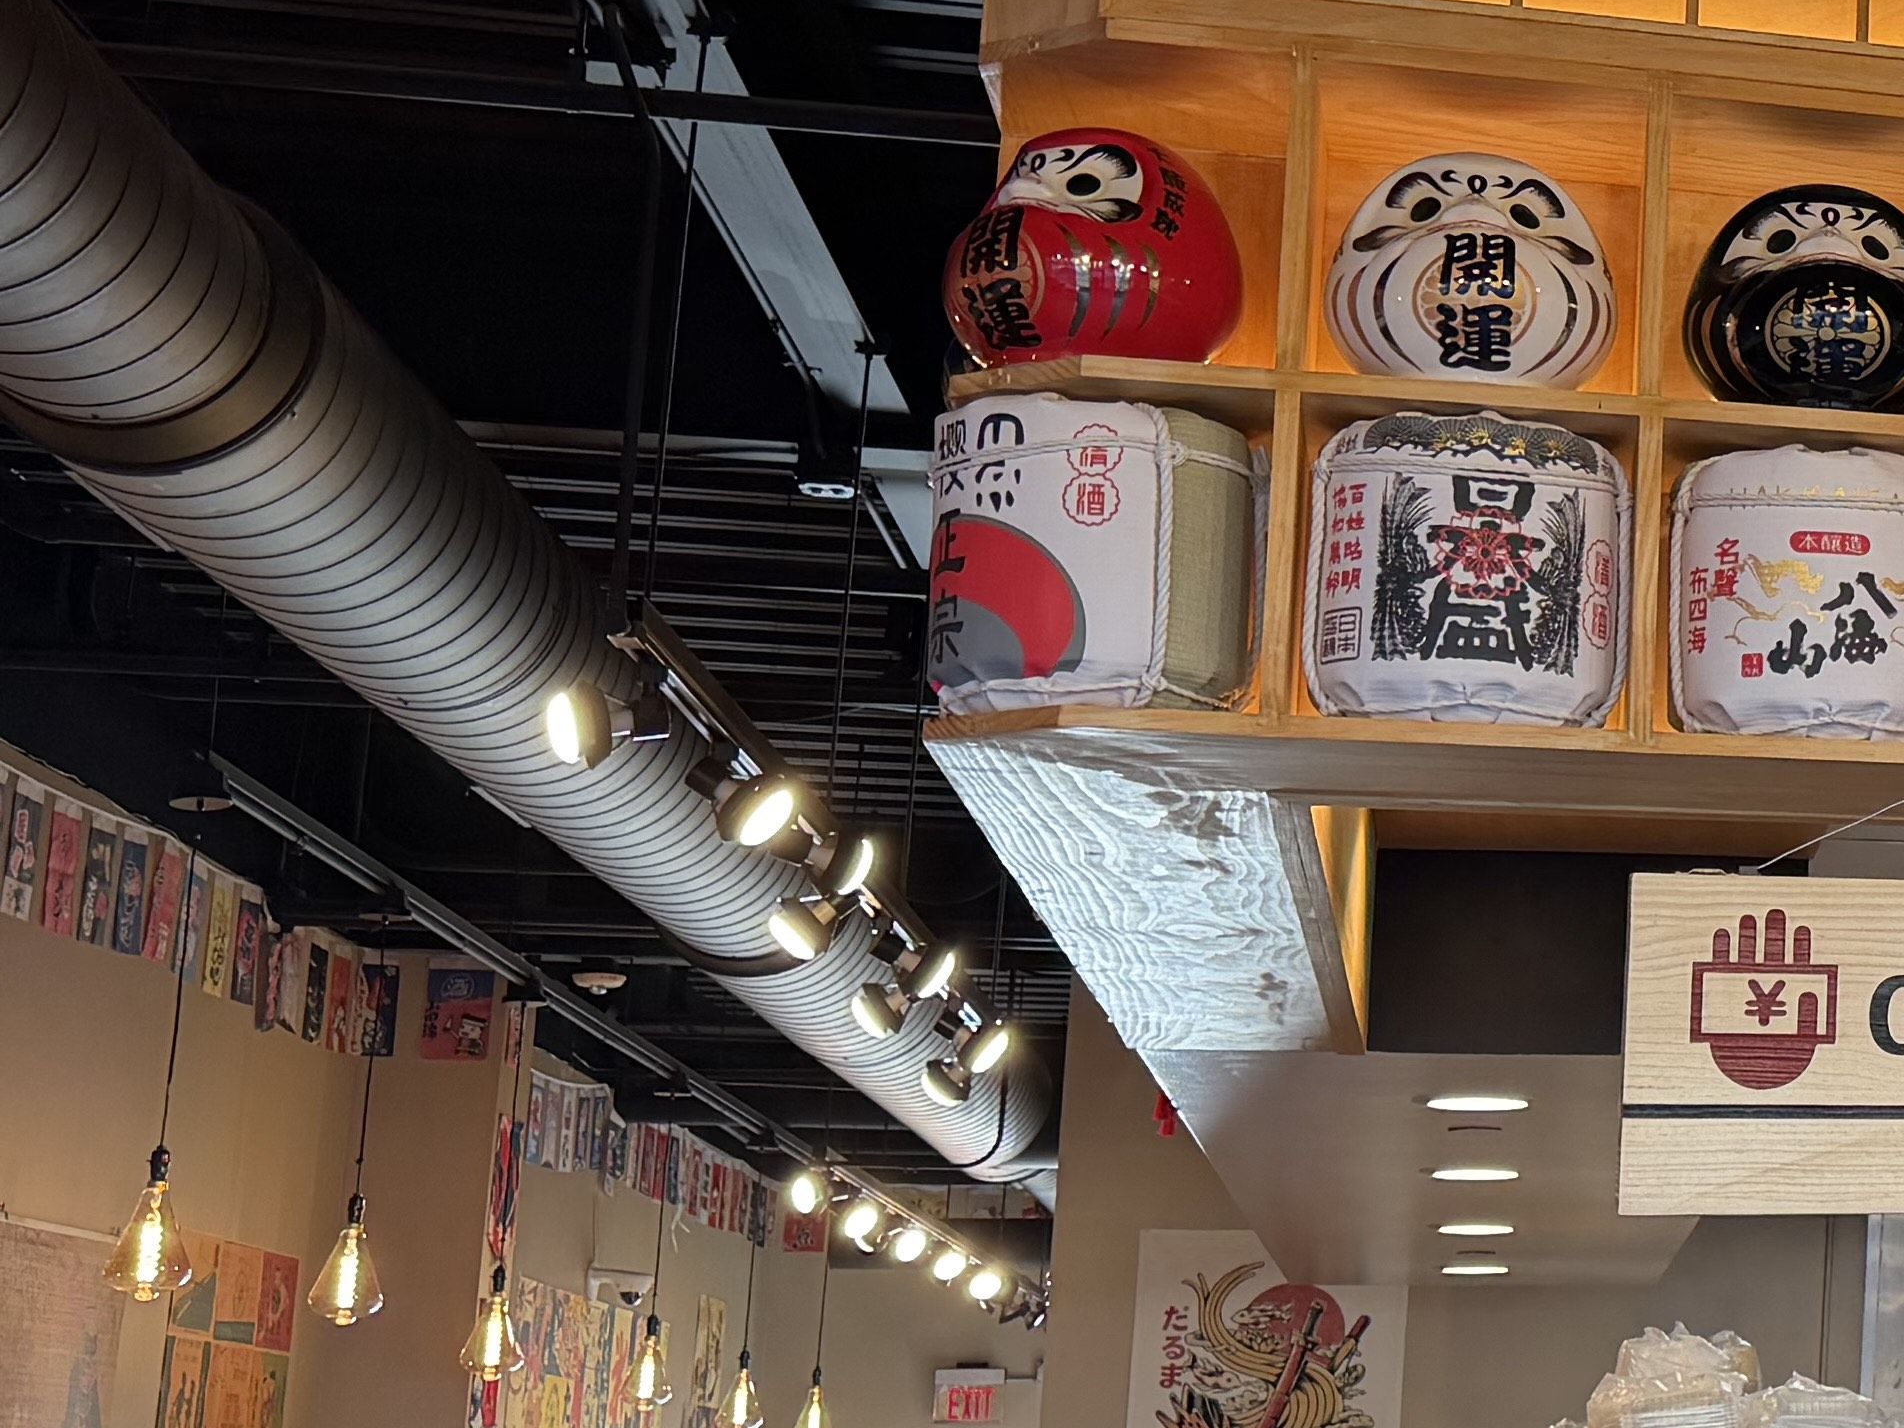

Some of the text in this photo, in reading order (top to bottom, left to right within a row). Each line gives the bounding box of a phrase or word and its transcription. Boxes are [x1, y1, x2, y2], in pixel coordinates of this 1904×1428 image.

[960, 206, 1042, 349] 開運
[1437, 231, 1518, 373] 開運
[947, 1386, 997, 1421] EXIT
[1160, 1305, 1190, 1389] だるま
